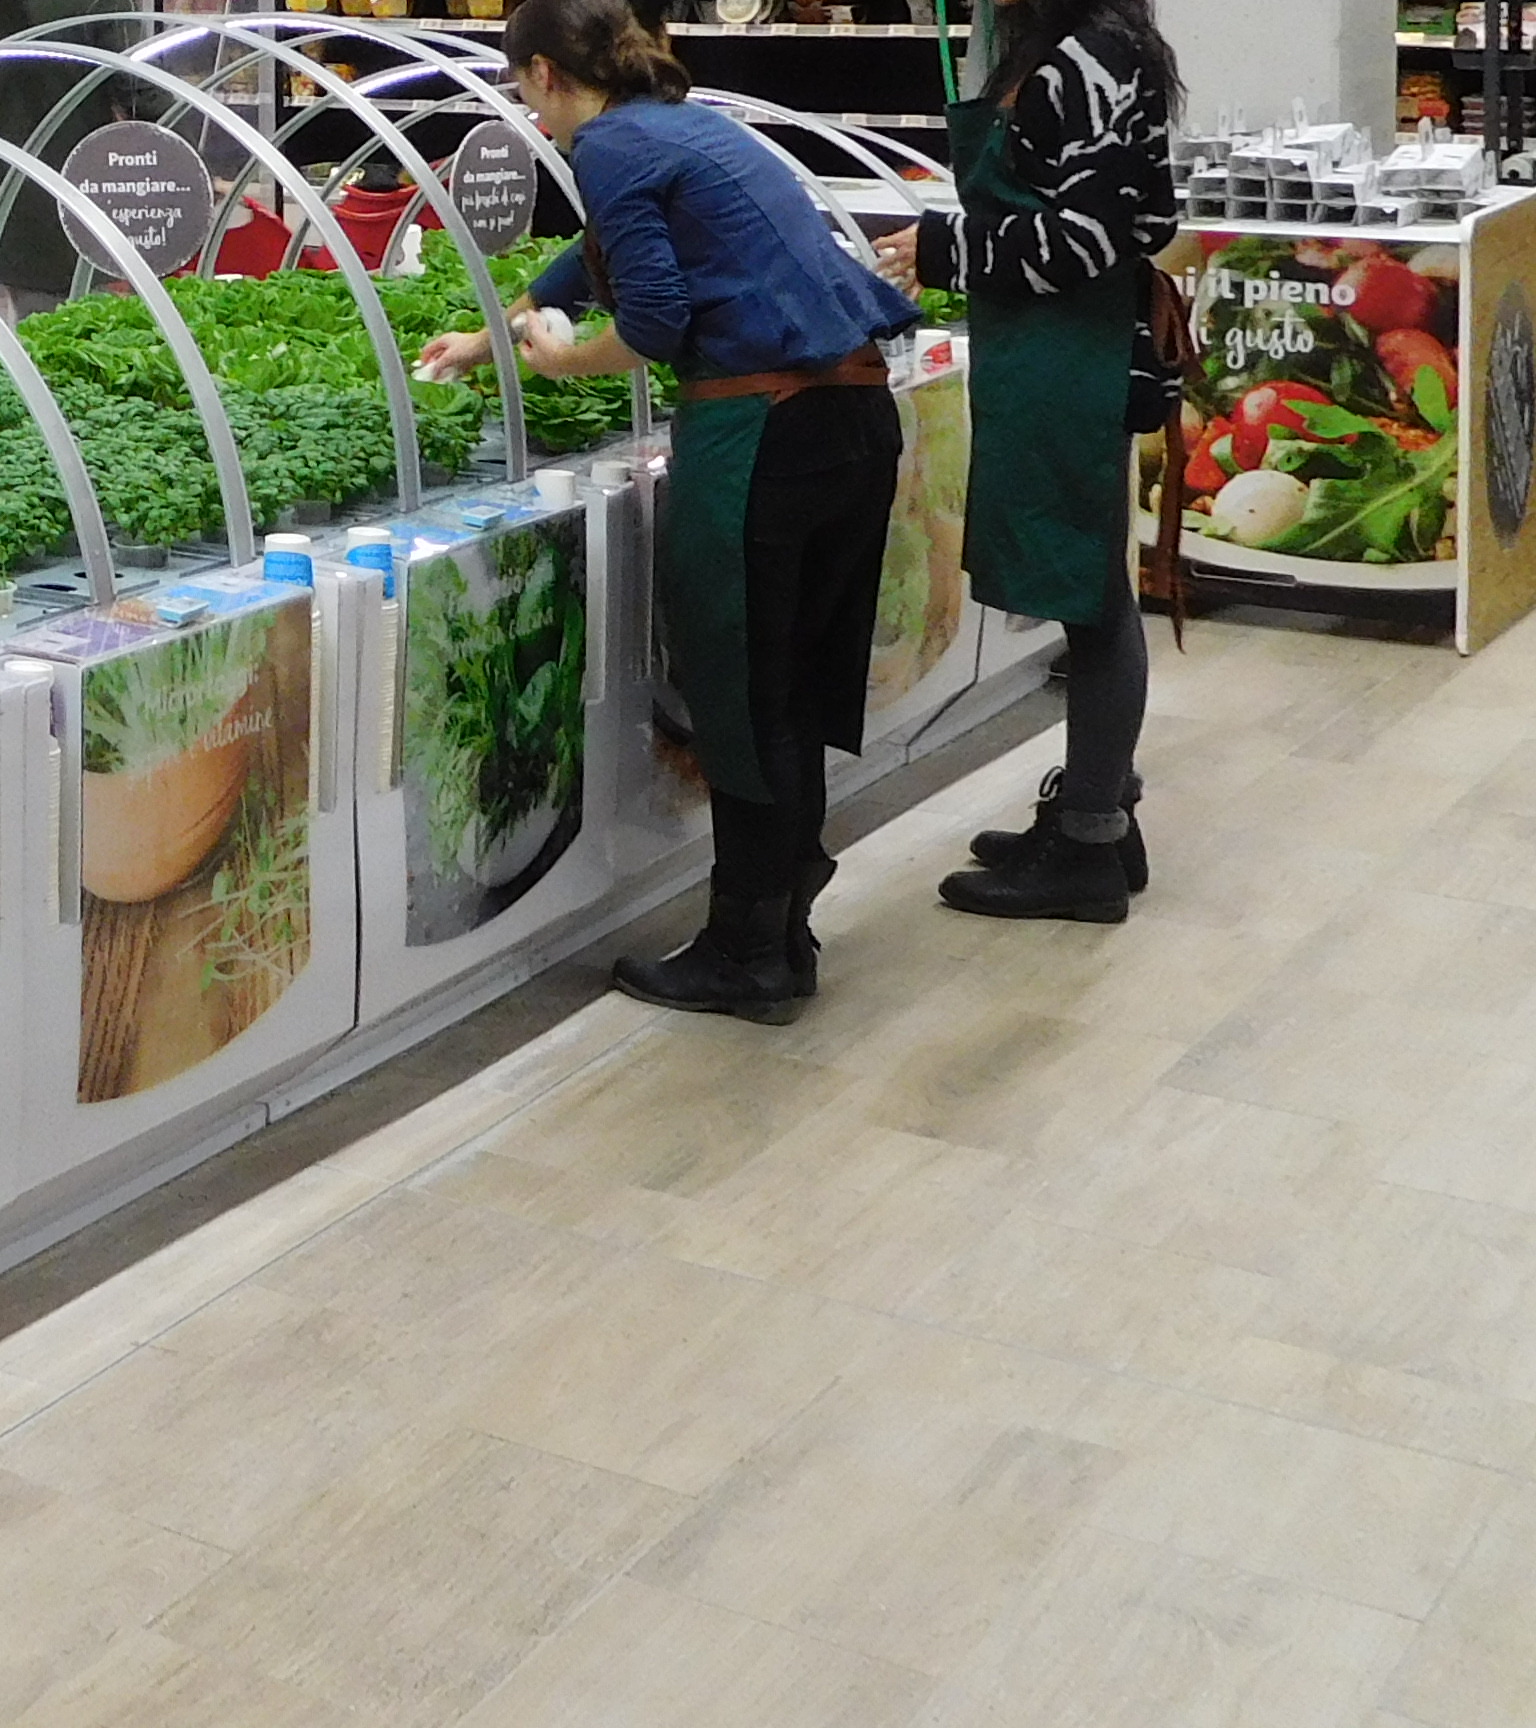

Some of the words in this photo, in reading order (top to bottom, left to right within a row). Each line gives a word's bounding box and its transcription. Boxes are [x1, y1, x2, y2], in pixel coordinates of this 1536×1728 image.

[108, 150, 158, 167] Pronti
[79, 179, 100, 194] da
[102, 177, 191, 197] mangiare...
[1206, 267, 1236, 300] il
[1243, 270, 1357, 309] pieno
[1224, 308, 1316, 370] gusto
